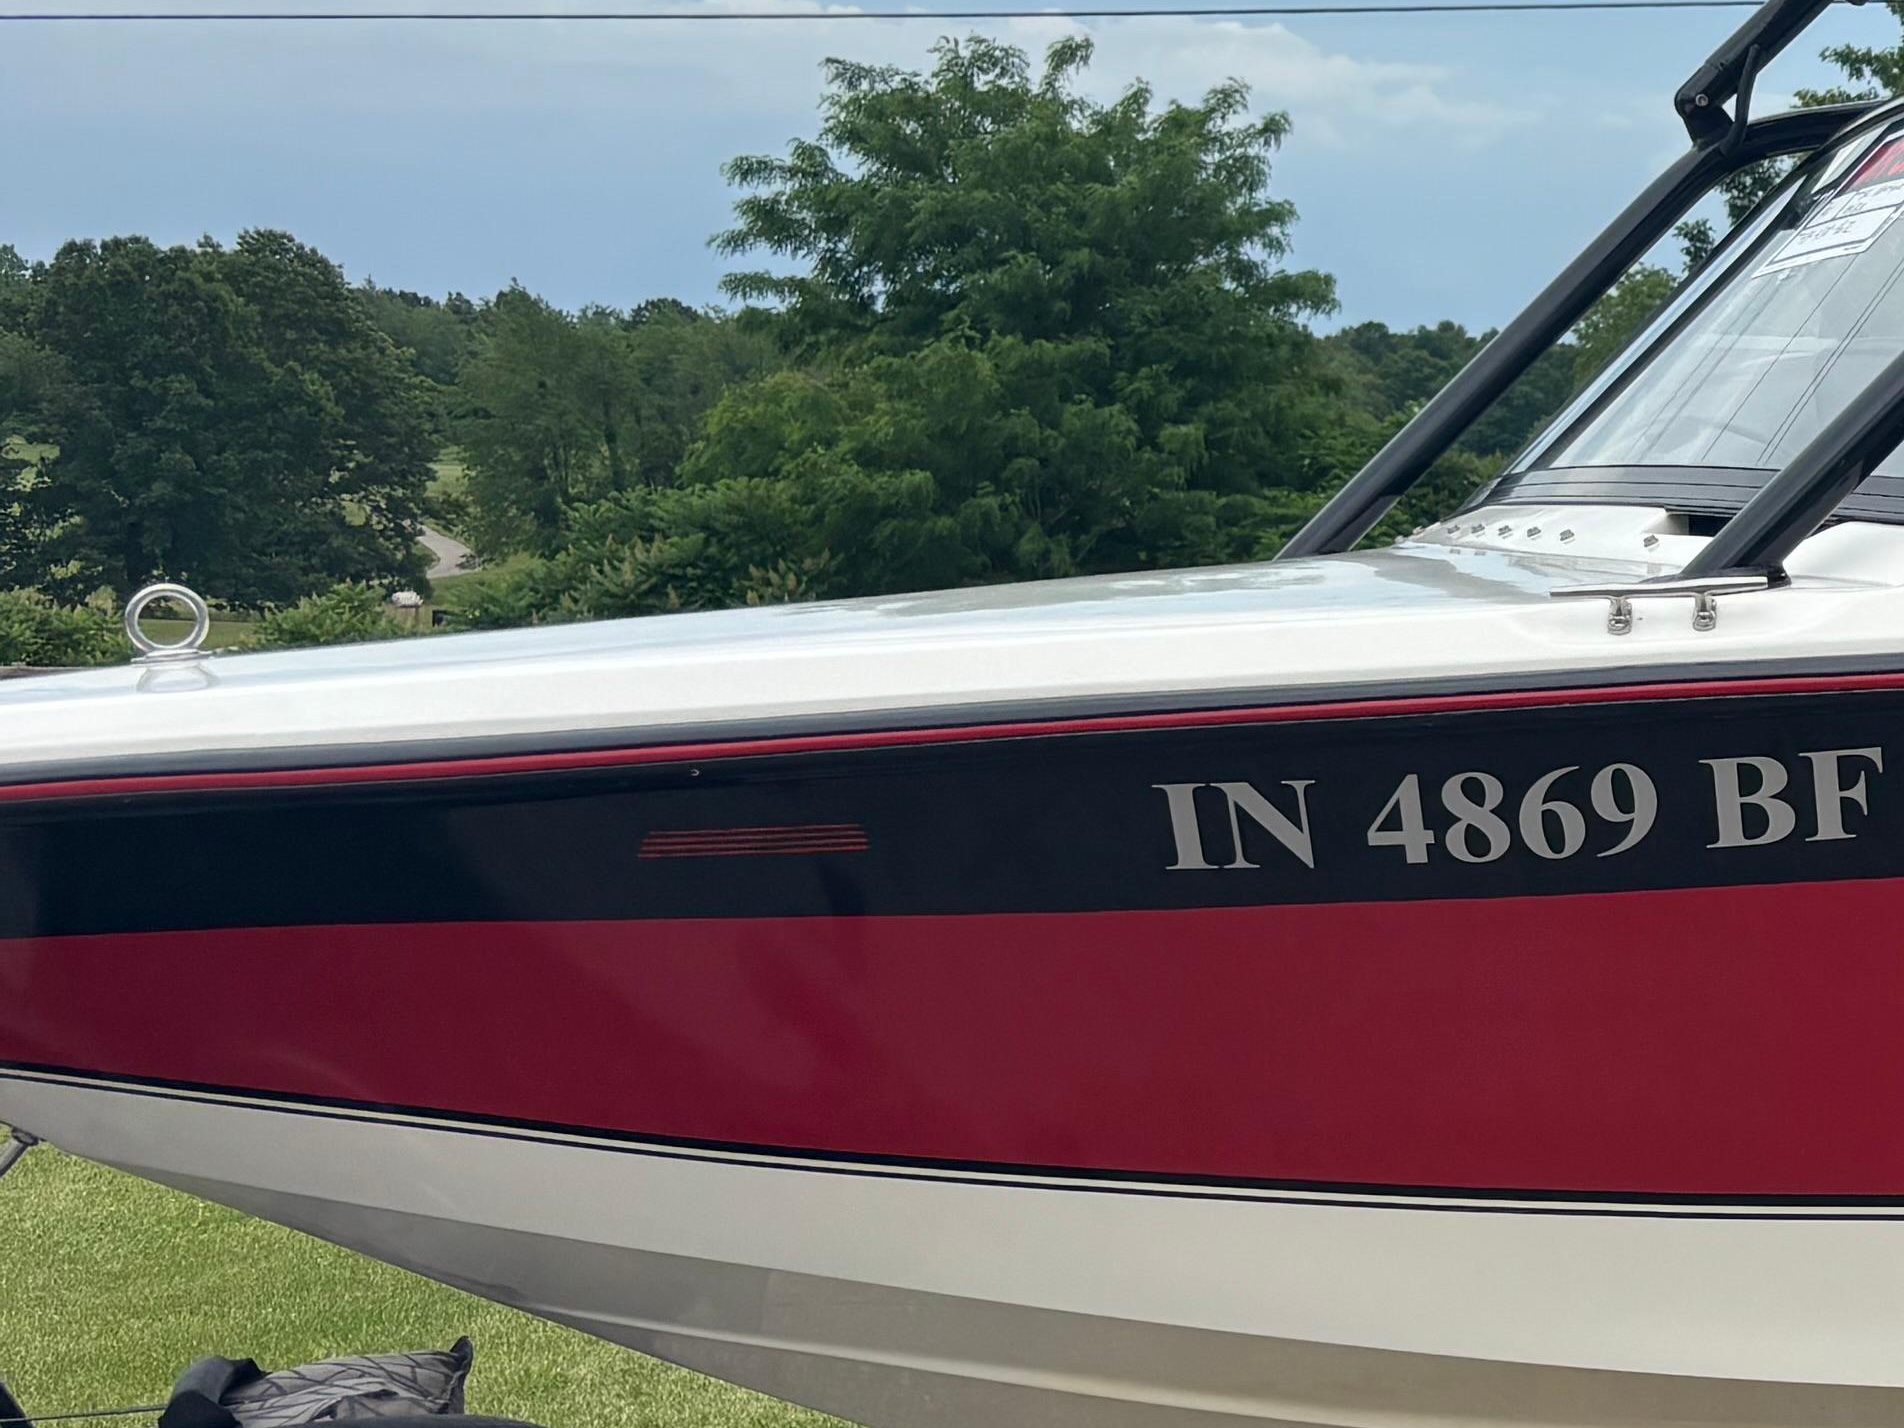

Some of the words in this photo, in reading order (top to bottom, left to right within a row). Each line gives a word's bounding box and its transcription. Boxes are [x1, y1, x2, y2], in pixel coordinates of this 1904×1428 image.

[1151, 779, 1316, 872] IN
[1366, 762, 1658, 865] 4869
[1697, 746, 1884, 851] BF
